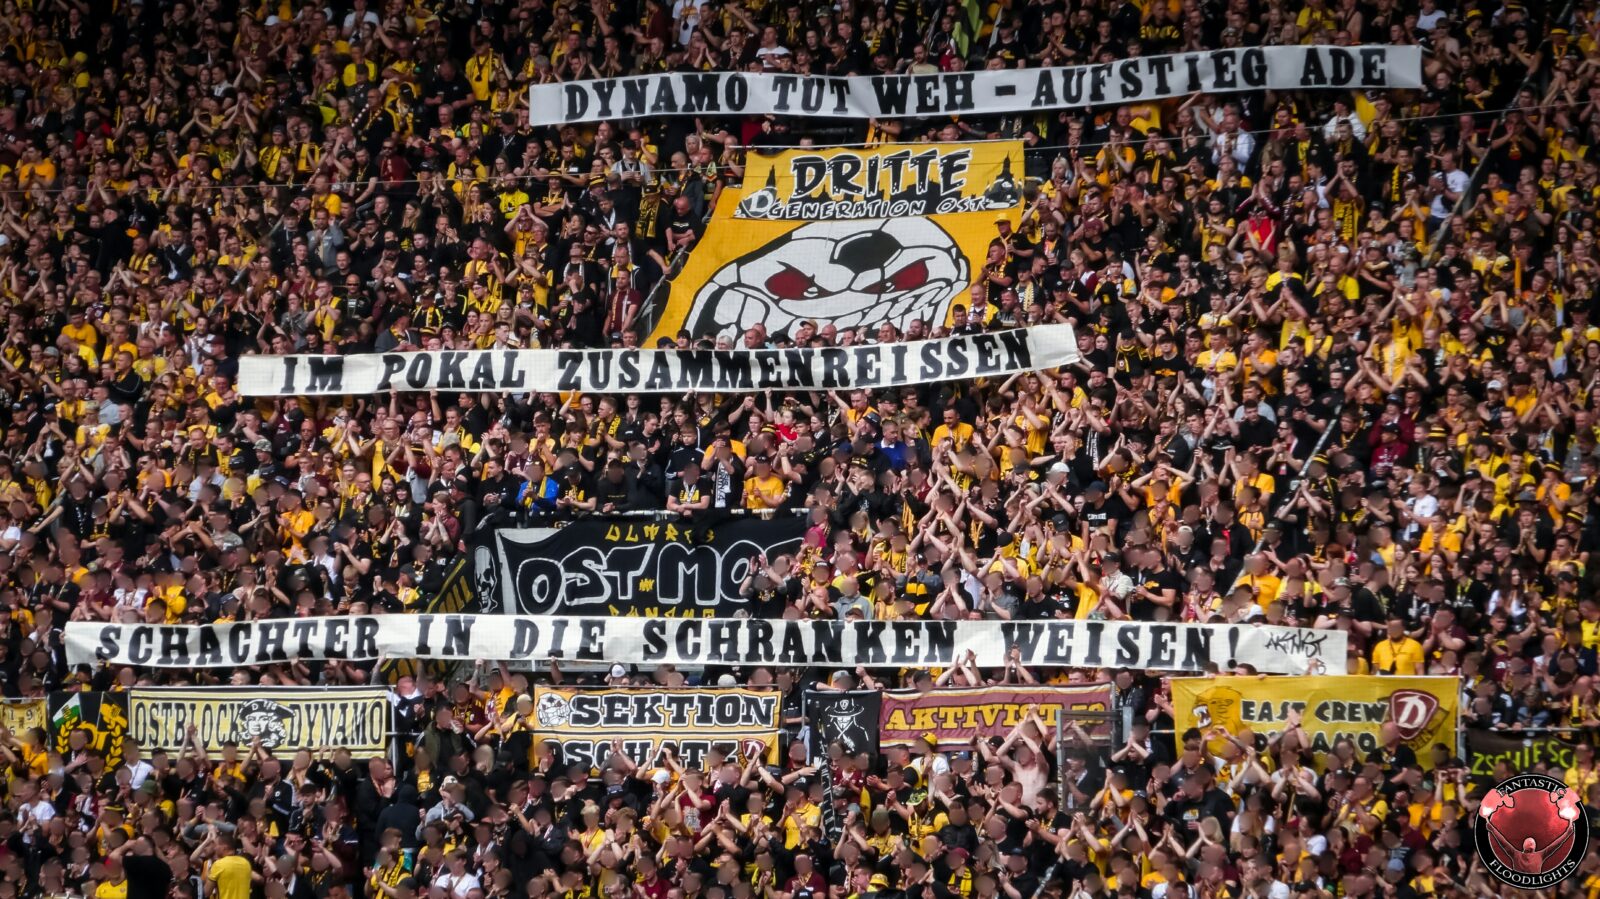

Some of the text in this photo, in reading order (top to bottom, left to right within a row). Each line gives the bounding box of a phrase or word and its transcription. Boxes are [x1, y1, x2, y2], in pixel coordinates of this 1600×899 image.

[565, 73, 748, 121] DYNAMO
[772, 75, 850, 114] TUT
[871, 73, 975, 115] WEH
[1031, 47, 1267, 107] AUFSTIEG
[1300, 47, 1386, 87] ADE
[791, 148, 971, 198] DRITTE
[767, 198, 926, 219] GENERATION
[280, 328, 1032, 394] IM POKAL ZUSAMMENREISSEN
[96, 614, 1240, 670] SCHACHTER IN DIE SCHRANKEN WEISEN!
[288, 701, 384, 748] DYNAMO
[569, 693, 777, 727] SEKTION
[1315, 699, 1391, 724] CREW
